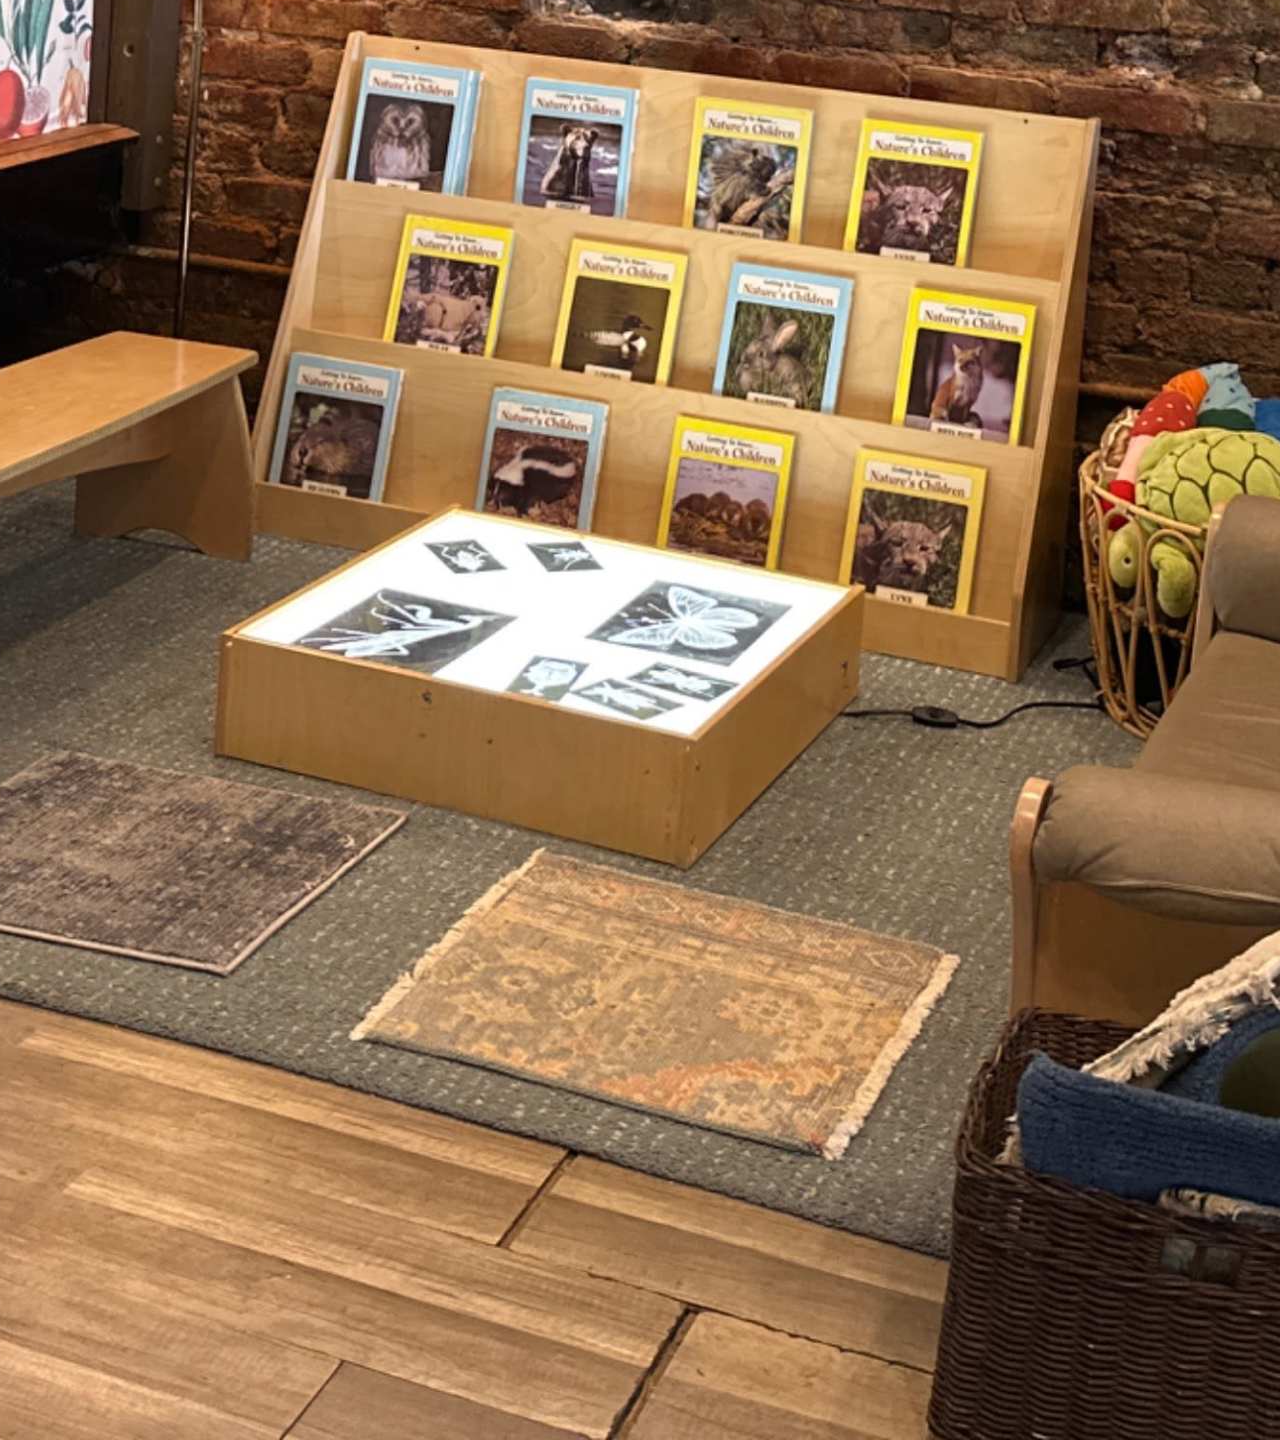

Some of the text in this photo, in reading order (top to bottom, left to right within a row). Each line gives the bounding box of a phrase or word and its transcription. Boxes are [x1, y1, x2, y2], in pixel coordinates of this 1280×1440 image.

[372, 76, 455, 97] Nature's Children
[536, 97, 621, 116] Nature's Children
[707, 118, 796, 140] Nature's Children
[874, 139, 967, 161] Nature's Children
[416, 237, 499, 258] Nature's Children
[582, 259, 669, 281] Nature's Children
[743, 282, 834, 307] Nature's Children
[924, 310, 1019, 335] Nature's Children
[301, 373, 384, 397] Nature's Children
[501, 409, 588, 433] Nature's Children
[686, 438, 777, 465] Nature's Children
[870, 468, 966, 498] Nature's Children
